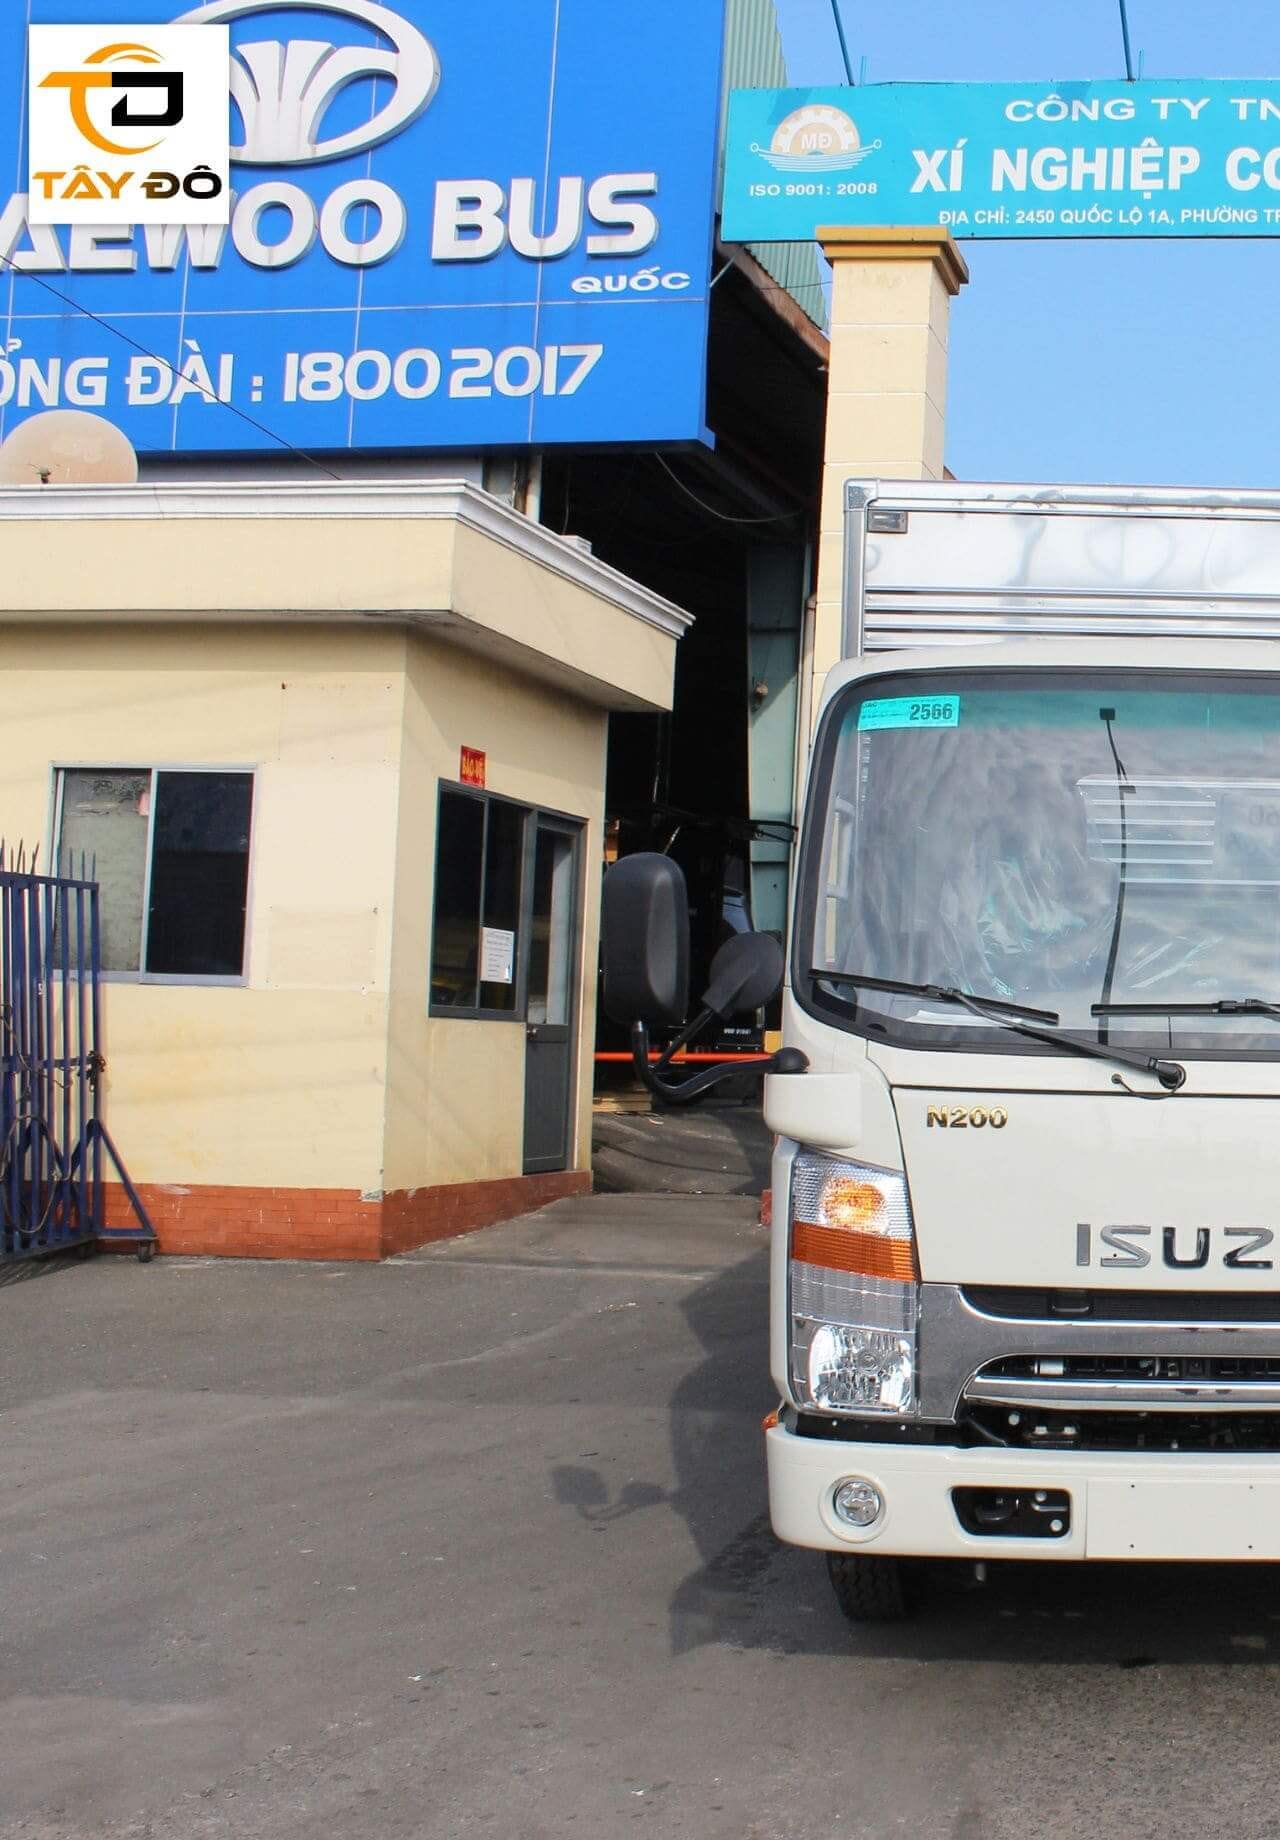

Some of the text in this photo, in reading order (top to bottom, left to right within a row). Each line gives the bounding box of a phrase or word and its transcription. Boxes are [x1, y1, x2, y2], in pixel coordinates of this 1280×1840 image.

[1004, 94, 1136, 122] CÔNG
[1151, 98, 1210, 121] TY
[909, 138, 967, 193] XÍ
[991, 136, 1201, 199] NGHIỆP
[750, 182, 878, 197] ISO 9001: 2008
[431, 172, 660, 263] BUS
[939, 209, 968, 226] ĐỊA
[974, 206, 1010, 224] CHỈ:
[1015, 209, 1055, 224] 2450
[1060, 204, 1113, 224] QUỐC
[1118, 207, 1143, 226] LỘ
[1149, 209, 1174, 226] 1A,
[1180, 206, 1258, 224] PHƯỜNG
[571, 266, 691, 294] QUỐC
[125, 339, 233, 407] ĐÀI
[909, 703, 953, 721] 2566
[926, 1105, 1008, 1130] N200
